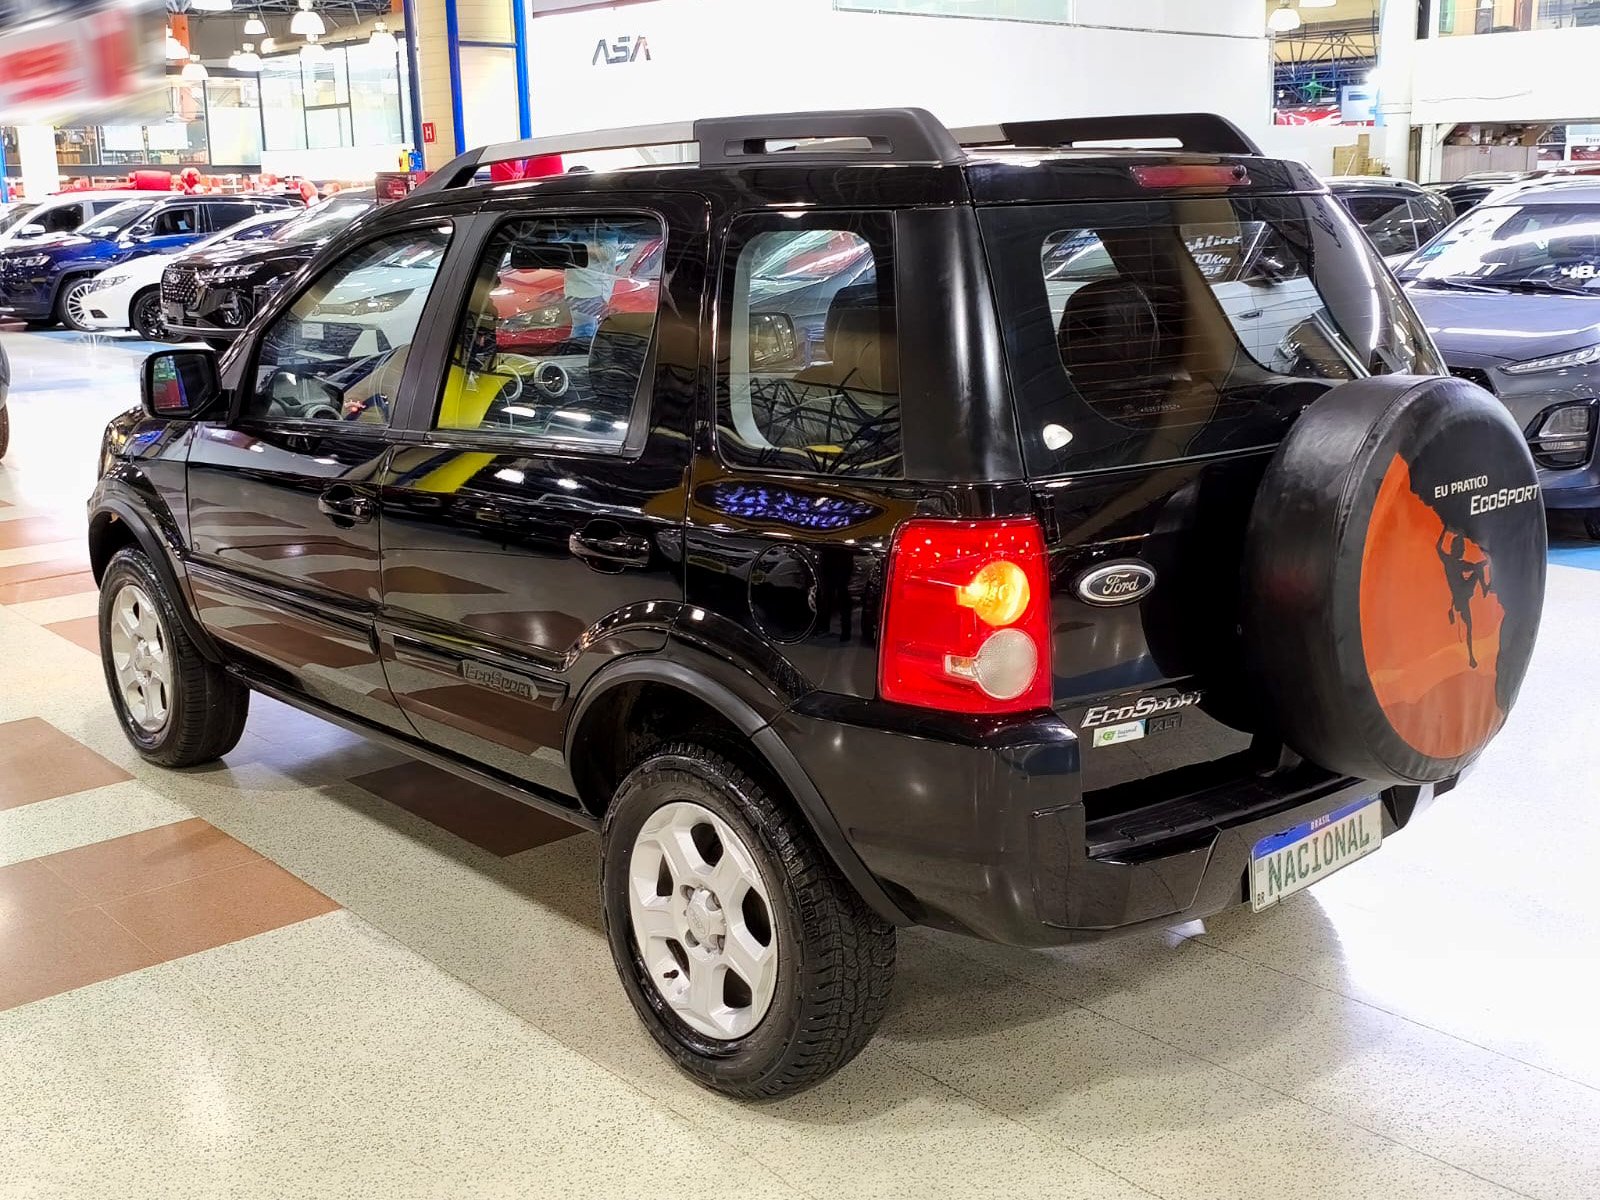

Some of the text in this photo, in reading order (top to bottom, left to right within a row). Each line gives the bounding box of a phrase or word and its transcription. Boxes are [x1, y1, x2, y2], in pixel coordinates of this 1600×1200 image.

[592, 35, 652, 65] ASA
[1434, 475, 1489, 499] EU PRATICO
[1102, 572, 1139, 595] Ford
[1151, 717, 1180, 732] XLT
[1310, 814, 1331, 831] BRASIL
[1268, 814, 1370, 897] NACIONAL
